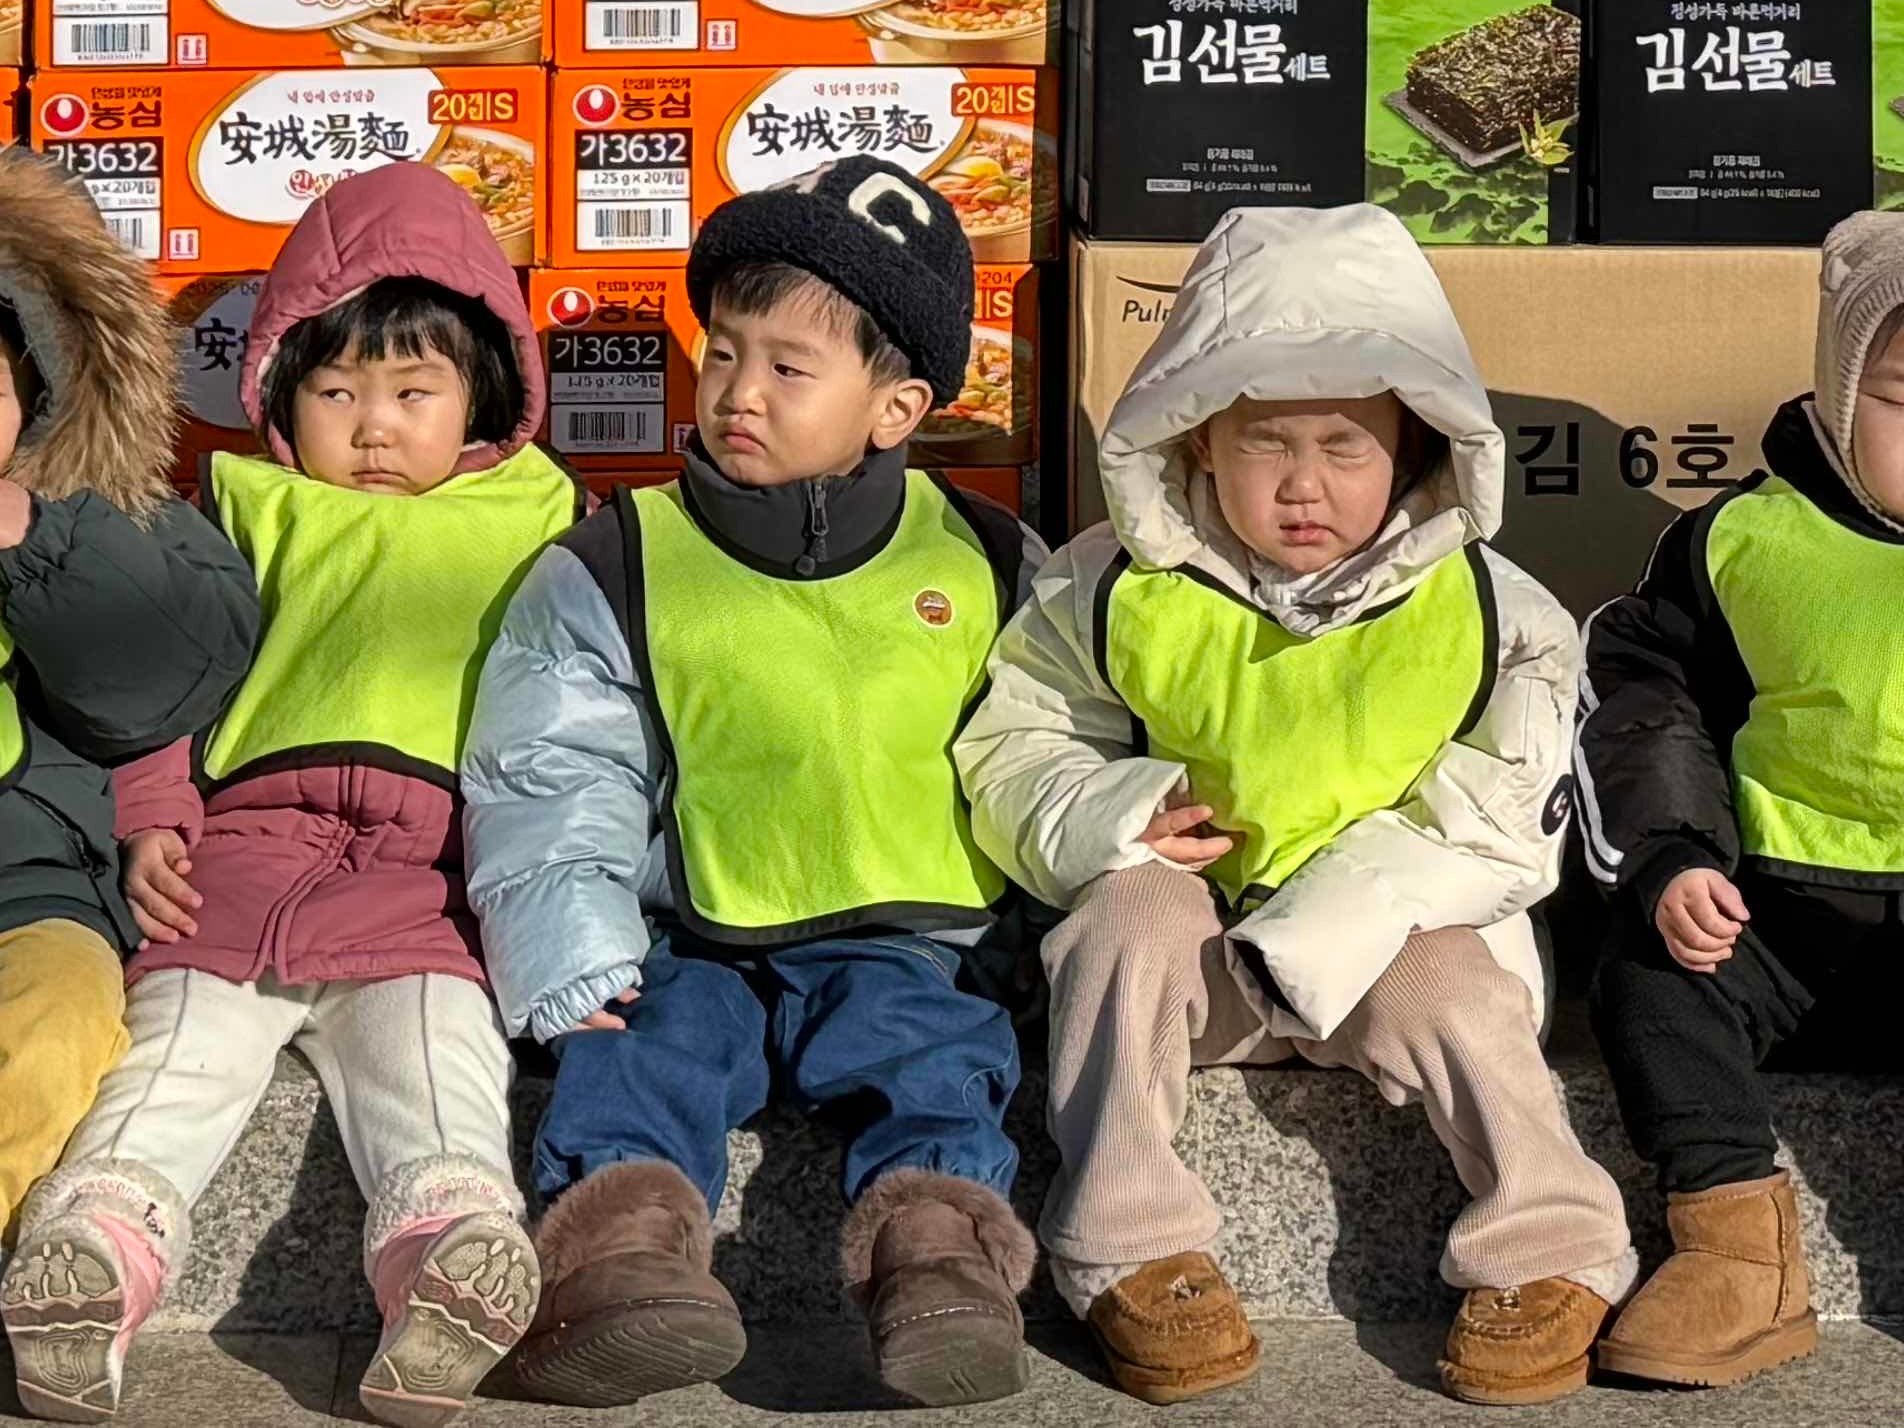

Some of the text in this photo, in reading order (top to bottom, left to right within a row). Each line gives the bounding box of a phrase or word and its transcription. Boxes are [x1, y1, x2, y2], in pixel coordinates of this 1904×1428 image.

[89, 101, 162, 130] 농심
[621, 92, 692, 120] 농심
[219, 111, 414, 166] 安城湯麵
[747, 105, 939, 156] 安城湯麵
[579, 134, 687, 166] 가3632
[597, 296, 666, 323] 농심
[555, 336, 662, 367] 가3632
[1515, 425, 1737, 495] 김 6호
